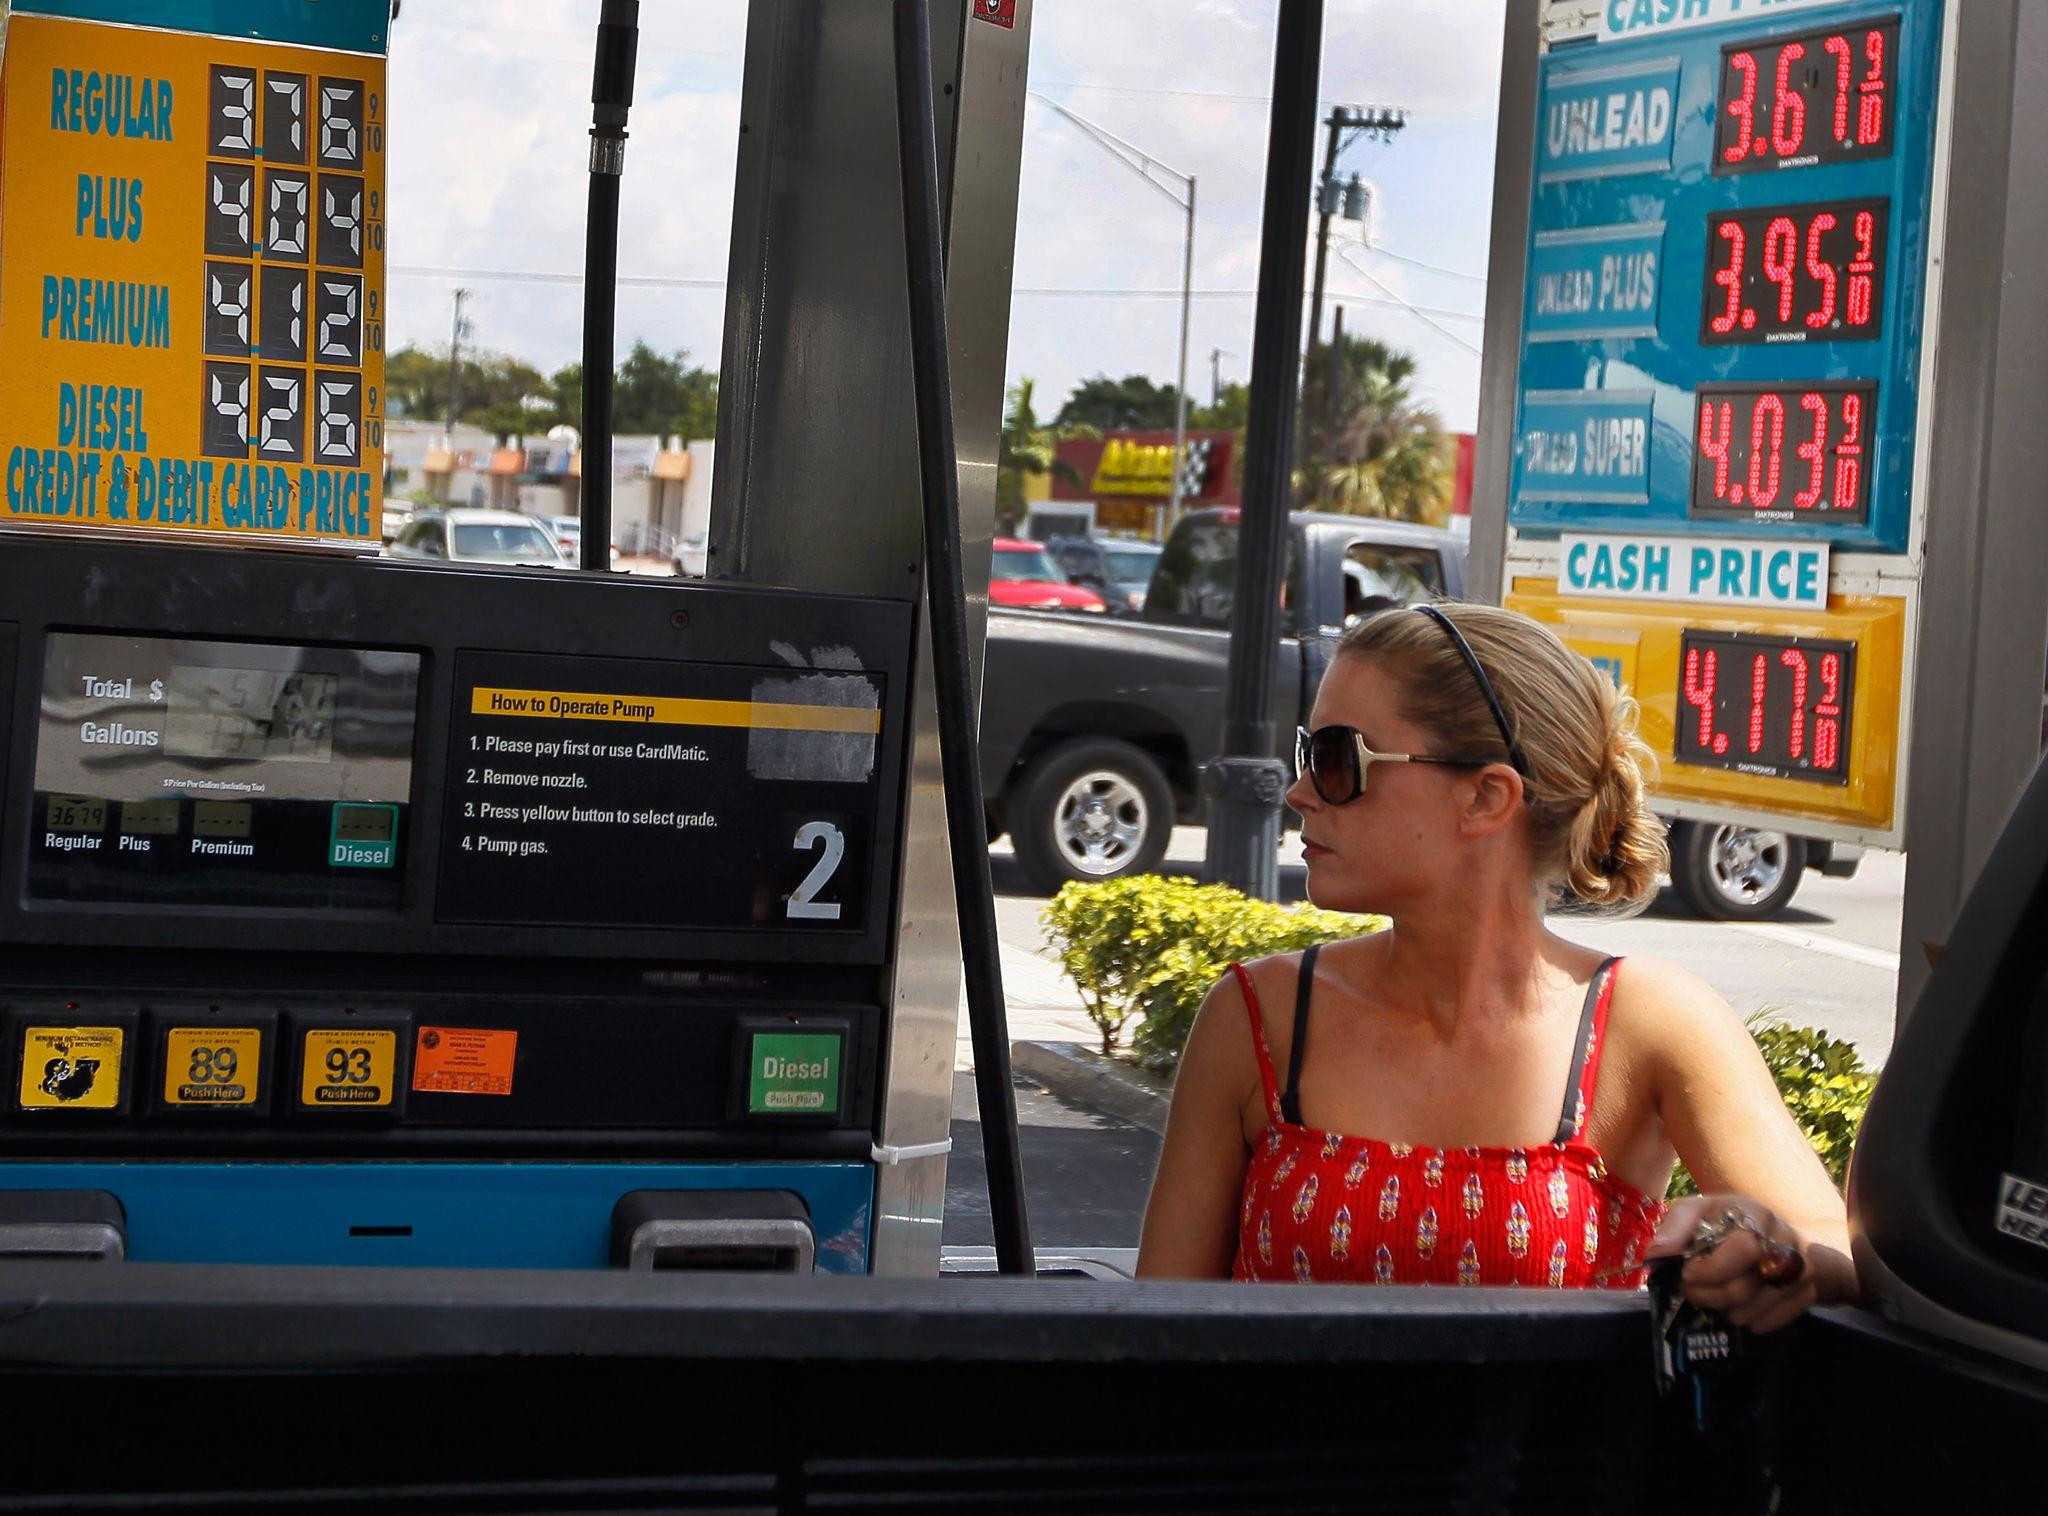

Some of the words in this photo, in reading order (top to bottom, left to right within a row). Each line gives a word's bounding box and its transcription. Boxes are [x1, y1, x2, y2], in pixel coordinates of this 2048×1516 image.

[51, 68, 173, 141] REGULAR
[1548, 88, 1670, 157] UNLEAD
[76, 174, 143, 243] PLUS
[1598, 250, 1656, 312] PLUS
[41, 275, 170, 349] PREMIUM
[58, 382, 147, 452] DIESEL
[1583, 416, 1645, 476] SUPER
[7, 445, 101, 518] CREDIT
[109, 454, 129, 520] &
[137, 457, 213, 525] DEBIT
[221, 462, 289, 529] CARD
[300, 469, 370, 536] PRICE
[1567, 542, 1671, 592] CASH
[1689, 548, 1819, 601] PRICE
[82, 675, 132, 699] Total
[149, 678, 163, 703] $
[491, 693, 527, 711] How
[531, 697, 545, 712] to
[550, 696, 608, 718] Operate
[612, 700, 655, 722] Pump
[81, 721, 159, 746] Gallons
[470, 736, 480, 750] 1.
[485, 736, 533, 753] Please
[535, 741, 560, 757] pay
[563, 739, 590, 756] first
[592, 743, 606, 756] or
[609, 744, 633, 758] use
[636, 743, 710, 761] CardMatic.
[199, 780, 219, 789] Gallon
[466, 769, 479, 784] 2.
[484, 769, 539, 787] Remove
[542, 773, 588, 788] nozzle.
[464, 803, 475, 817] 3.
[480, 803, 519, 819] Press
[522, 805, 569, 822] yellow
[572, 806, 614, 823] button
[617, 810, 630, 823] to
[632, 809, 674, 826] select
[677, 812, 718, 829] grade.
[45, 833, 102, 851] Regular
[119, 836, 150, 851] Plus
[191, 839, 254, 855] Premium
[334, 845, 389, 863] Diesel
[461, 836, 473, 851] 4.
[478, 836, 517, 855] Pump
[520, 841, 548, 856] gas.
[786, 820, 845, 920] 2
[188, 1047, 238, 1084] 89
[325, 1047, 371, 1084] 93
[764, 1056, 829, 1079] Diesel
[184, 1087, 211, 1098] Push
[213, 1087, 239, 1098] Here
[321, 1088, 347, 1098] Push
[350, 1089, 374, 1099] Here
[770, 1093, 793, 1104] Push
